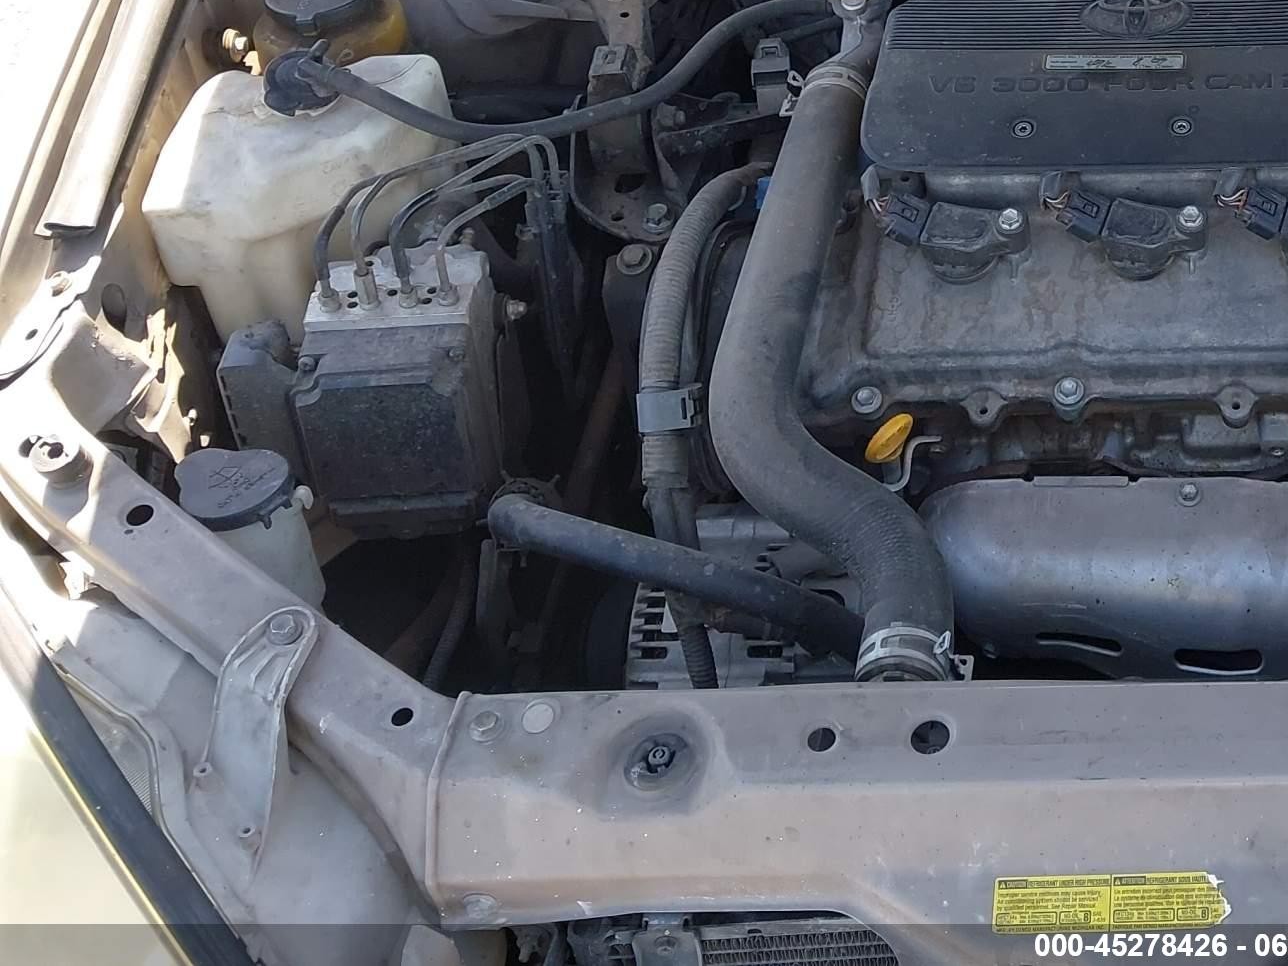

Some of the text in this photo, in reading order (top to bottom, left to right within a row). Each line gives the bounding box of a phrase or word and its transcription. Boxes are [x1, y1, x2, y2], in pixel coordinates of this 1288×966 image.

[991, 75, 1089, 94] 3000
[1103, 74, 1195, 92] FOUR
[1204, 72, 1274, 91] CAM
